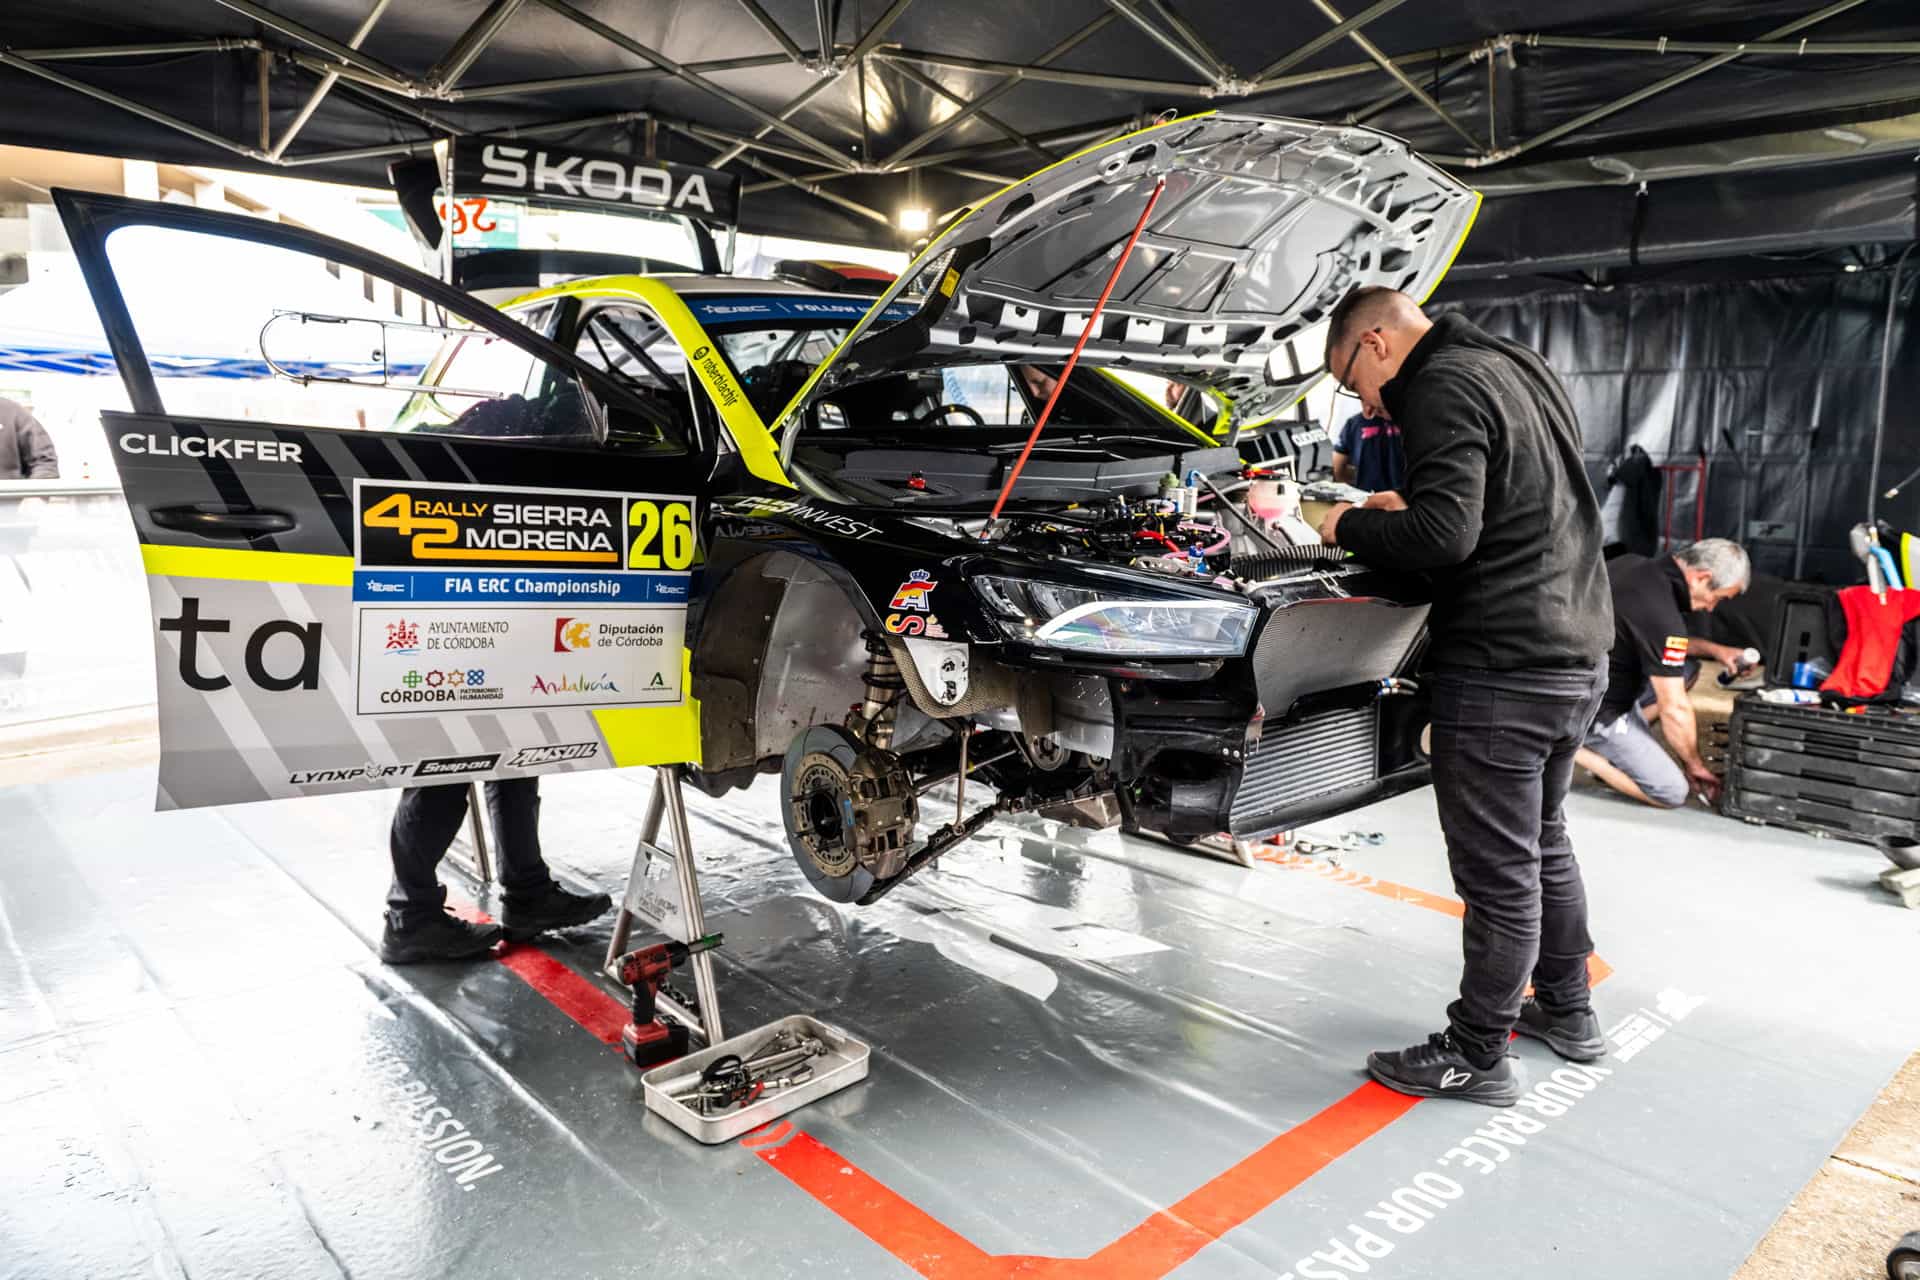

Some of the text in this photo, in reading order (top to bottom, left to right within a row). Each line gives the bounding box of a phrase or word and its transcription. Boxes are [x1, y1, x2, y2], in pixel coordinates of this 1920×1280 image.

[119, 433, 303, 463] CLICKFER
[414, 501, 612, 527] RALLY SIERRA
[466, 528, 613, 551] MORENA
[628, 501, 694, 570] 26
[445, 578, 621, 596] FIA ERC Championship
[427, 620, 510, 634] AYUNTAMIENTO
[599, 623, 664, 636] Diputación
[159, 597, 323, 691] ta
[427, 635, 496, 649] DE CÓRDOBA
[598, 636, 664, 647] de Córdoba
[530, 672, 620, 695] Andalucía
[380, 689, 457, 703] CÓRDOBA
[421, 758, 492, 774] Snap-on
[506, 742, 599, 768] AMSOIL
[1516, 1061, 1613, 1117] YOUR
[1437, 1110, 1547, 1175] RACE.
[1364, 1171, 1465, 1234] OUR
